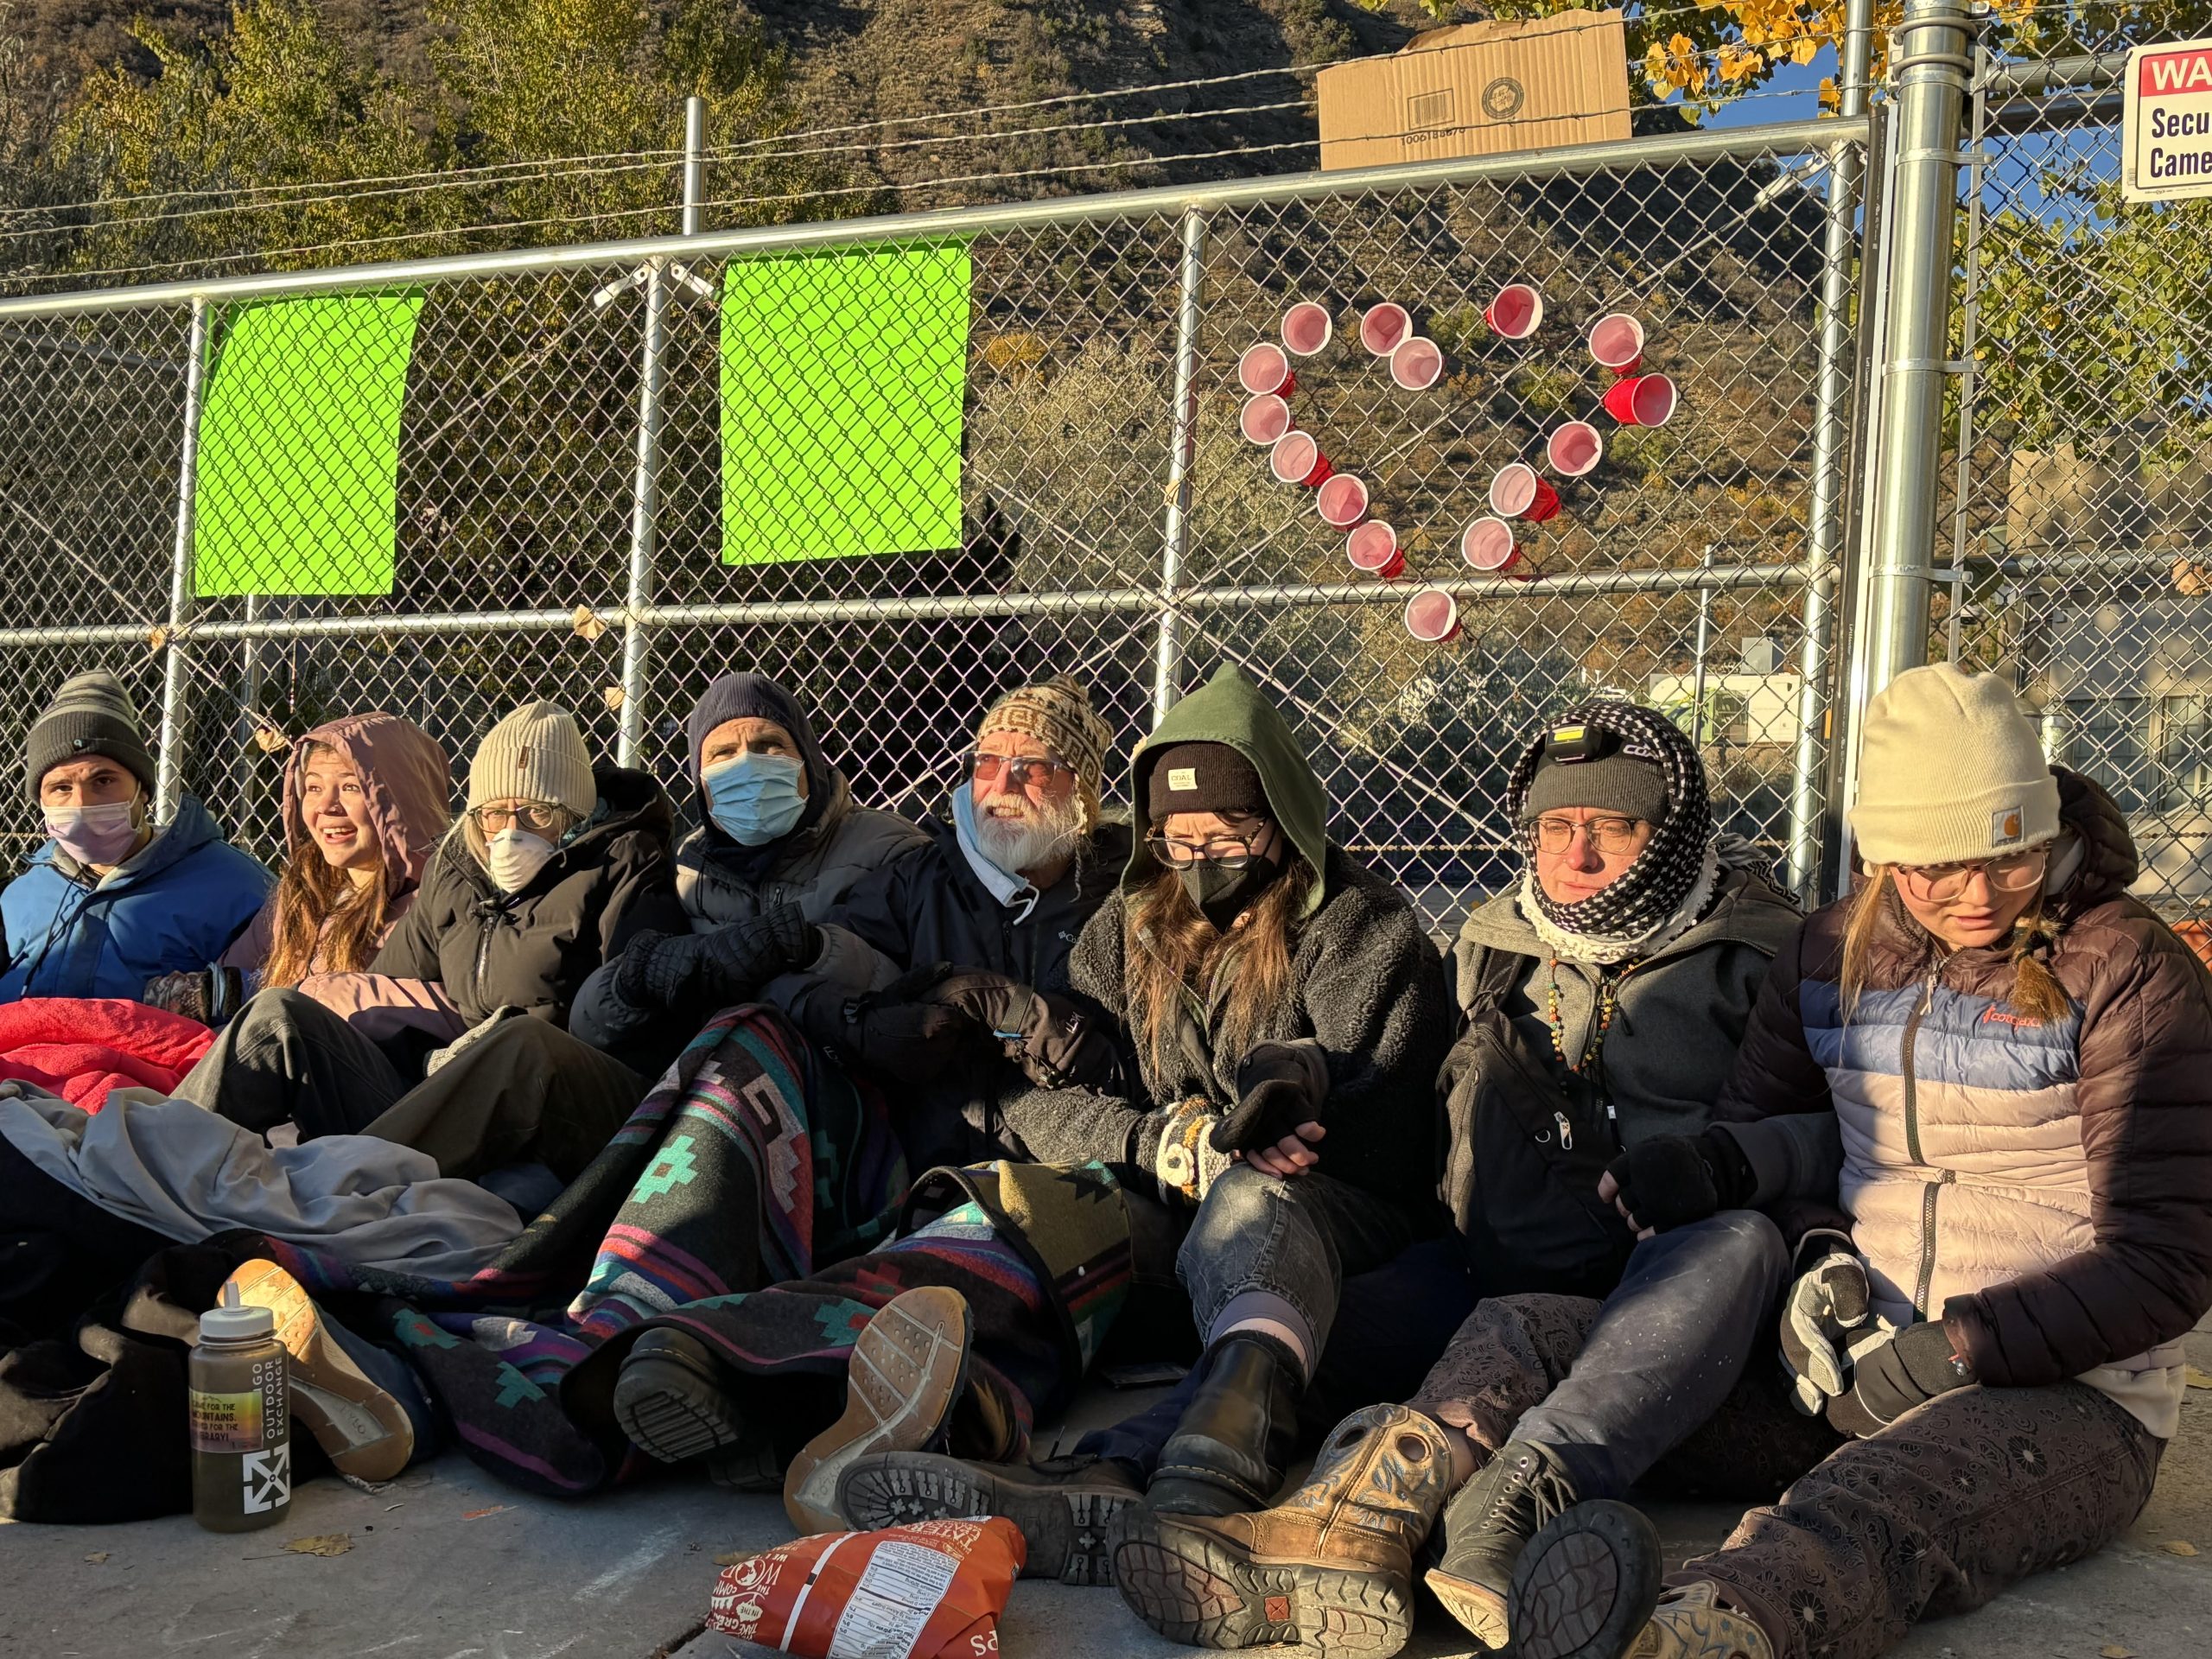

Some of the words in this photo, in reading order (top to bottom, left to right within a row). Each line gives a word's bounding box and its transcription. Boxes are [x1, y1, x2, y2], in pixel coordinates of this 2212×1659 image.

[2152, 56, 2212, 91] WA
[2152, 107, 2209, 138] Secu
[2150, 147, 2212, 178] Came
[264, 1361, 276, 1440] OUTDOOR
[275, 1357, 284, 1436] EXCHANGE
[741, 1606, 751, 1615] THE
